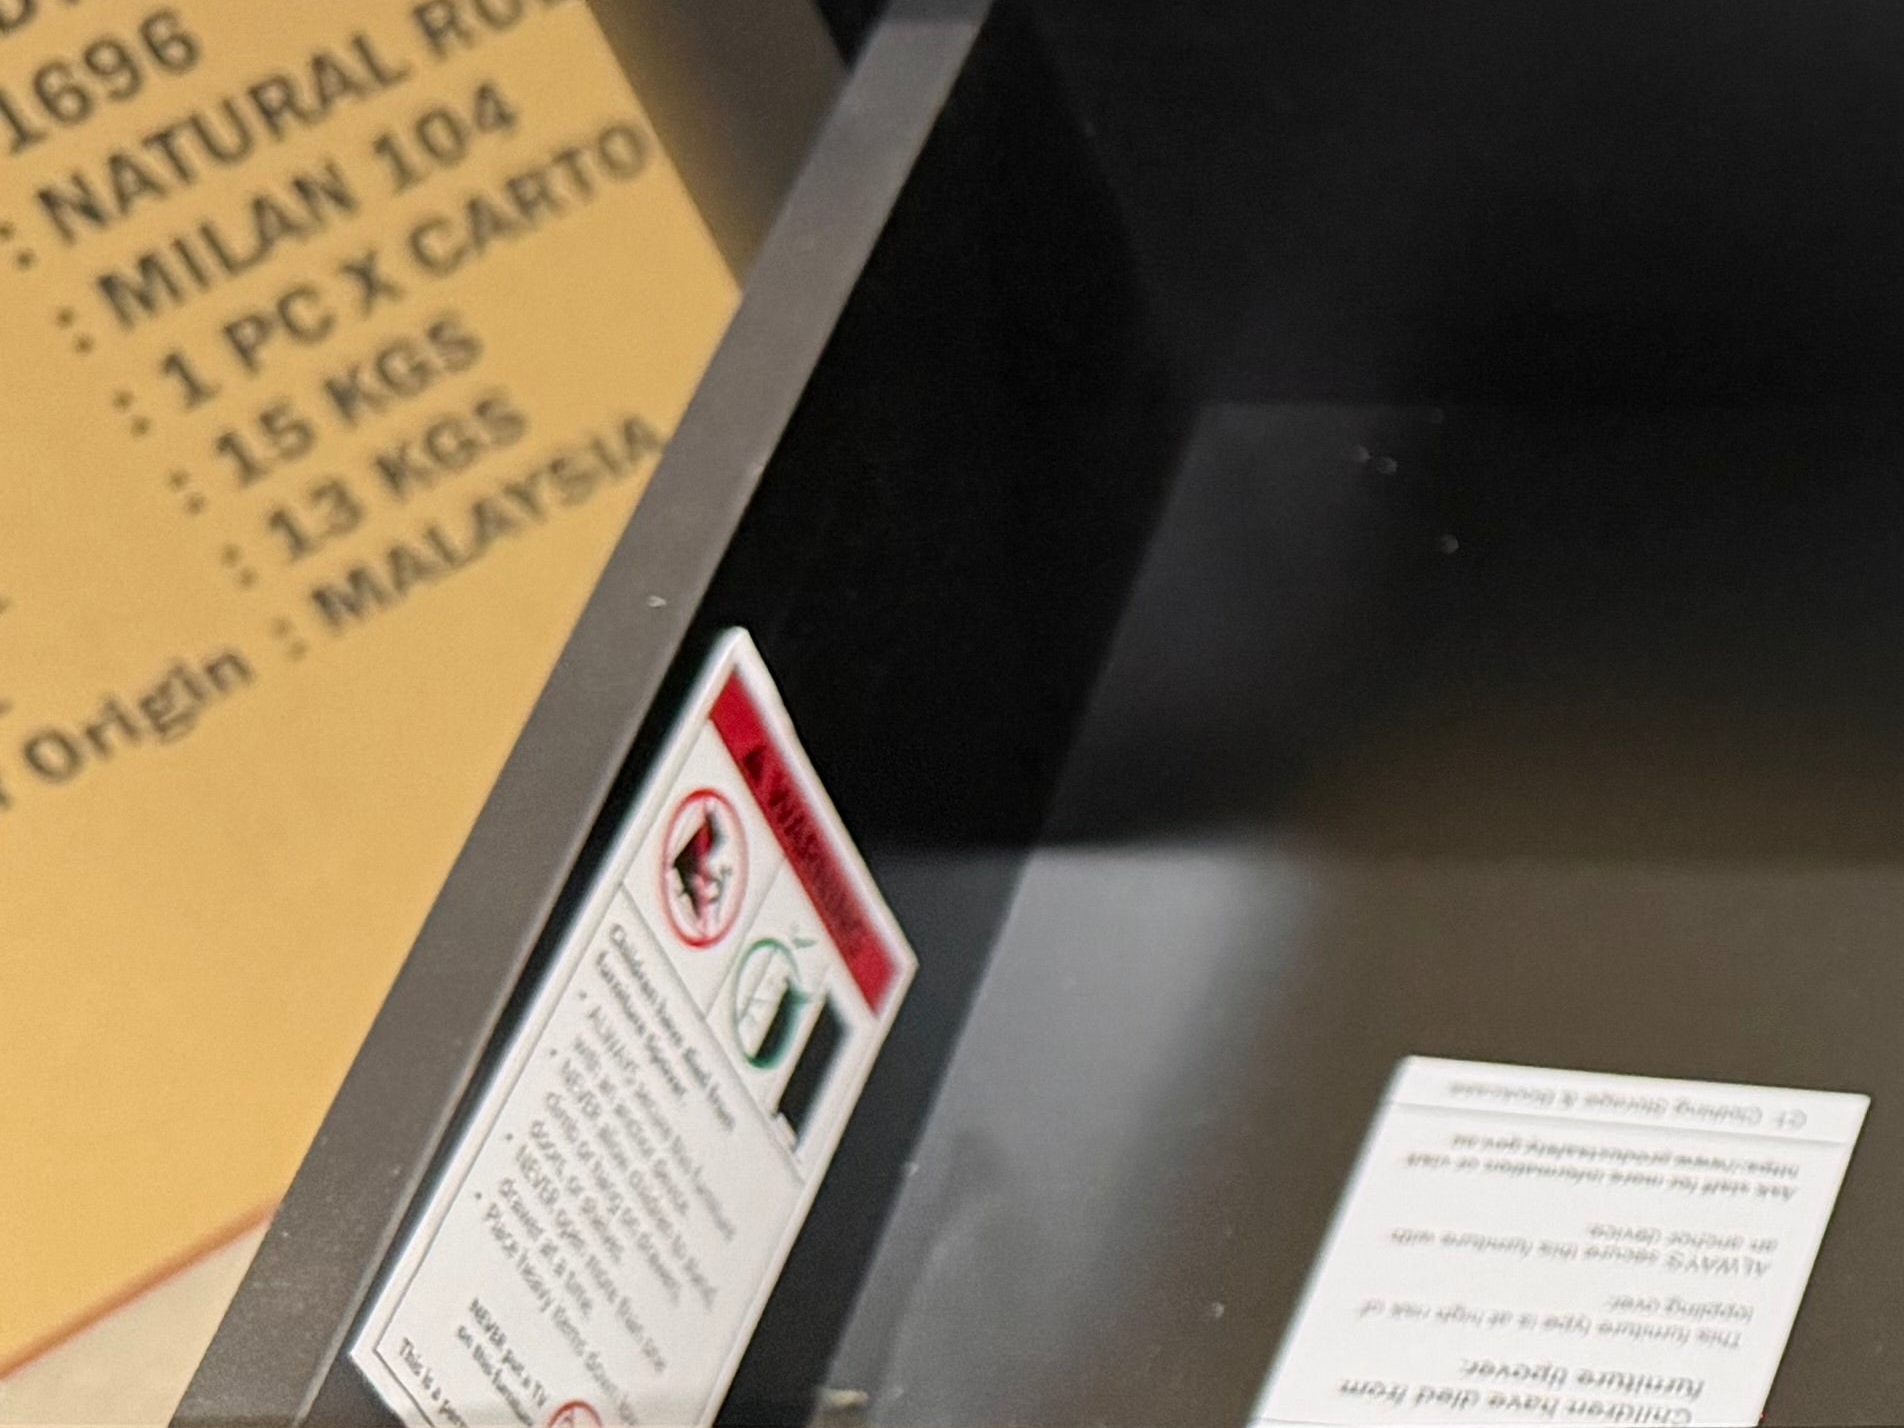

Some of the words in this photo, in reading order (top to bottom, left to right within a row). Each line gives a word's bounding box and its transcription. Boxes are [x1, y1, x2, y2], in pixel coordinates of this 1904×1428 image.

[0, 6, 202, 155] 1696
[37, 30, 413, 245] NATURAL
[97, 161, 361, 331] MILAN
[370, 77, 520, 196] 104
[157, 350, 222, 411] 1
[222, 283, 341, 377] PC
[405, 119, 653, 275] CARTO
[212, 400, 319, 491] 15
[322, 311, 487, 429] KGS
[265, 475, 368, 565] 13
[373, 386, 533, 504] KGS
[22, 644, 255, 785] Origin
[309, 411, 668, 638] MALAYSIA
[484, 1200, 521, 1263] Place
[1482, 1393, 1559, 1418] have
[1564, 1399, 1694, 1428] Children
[1572, 1370, 1704, 1401] furniture
